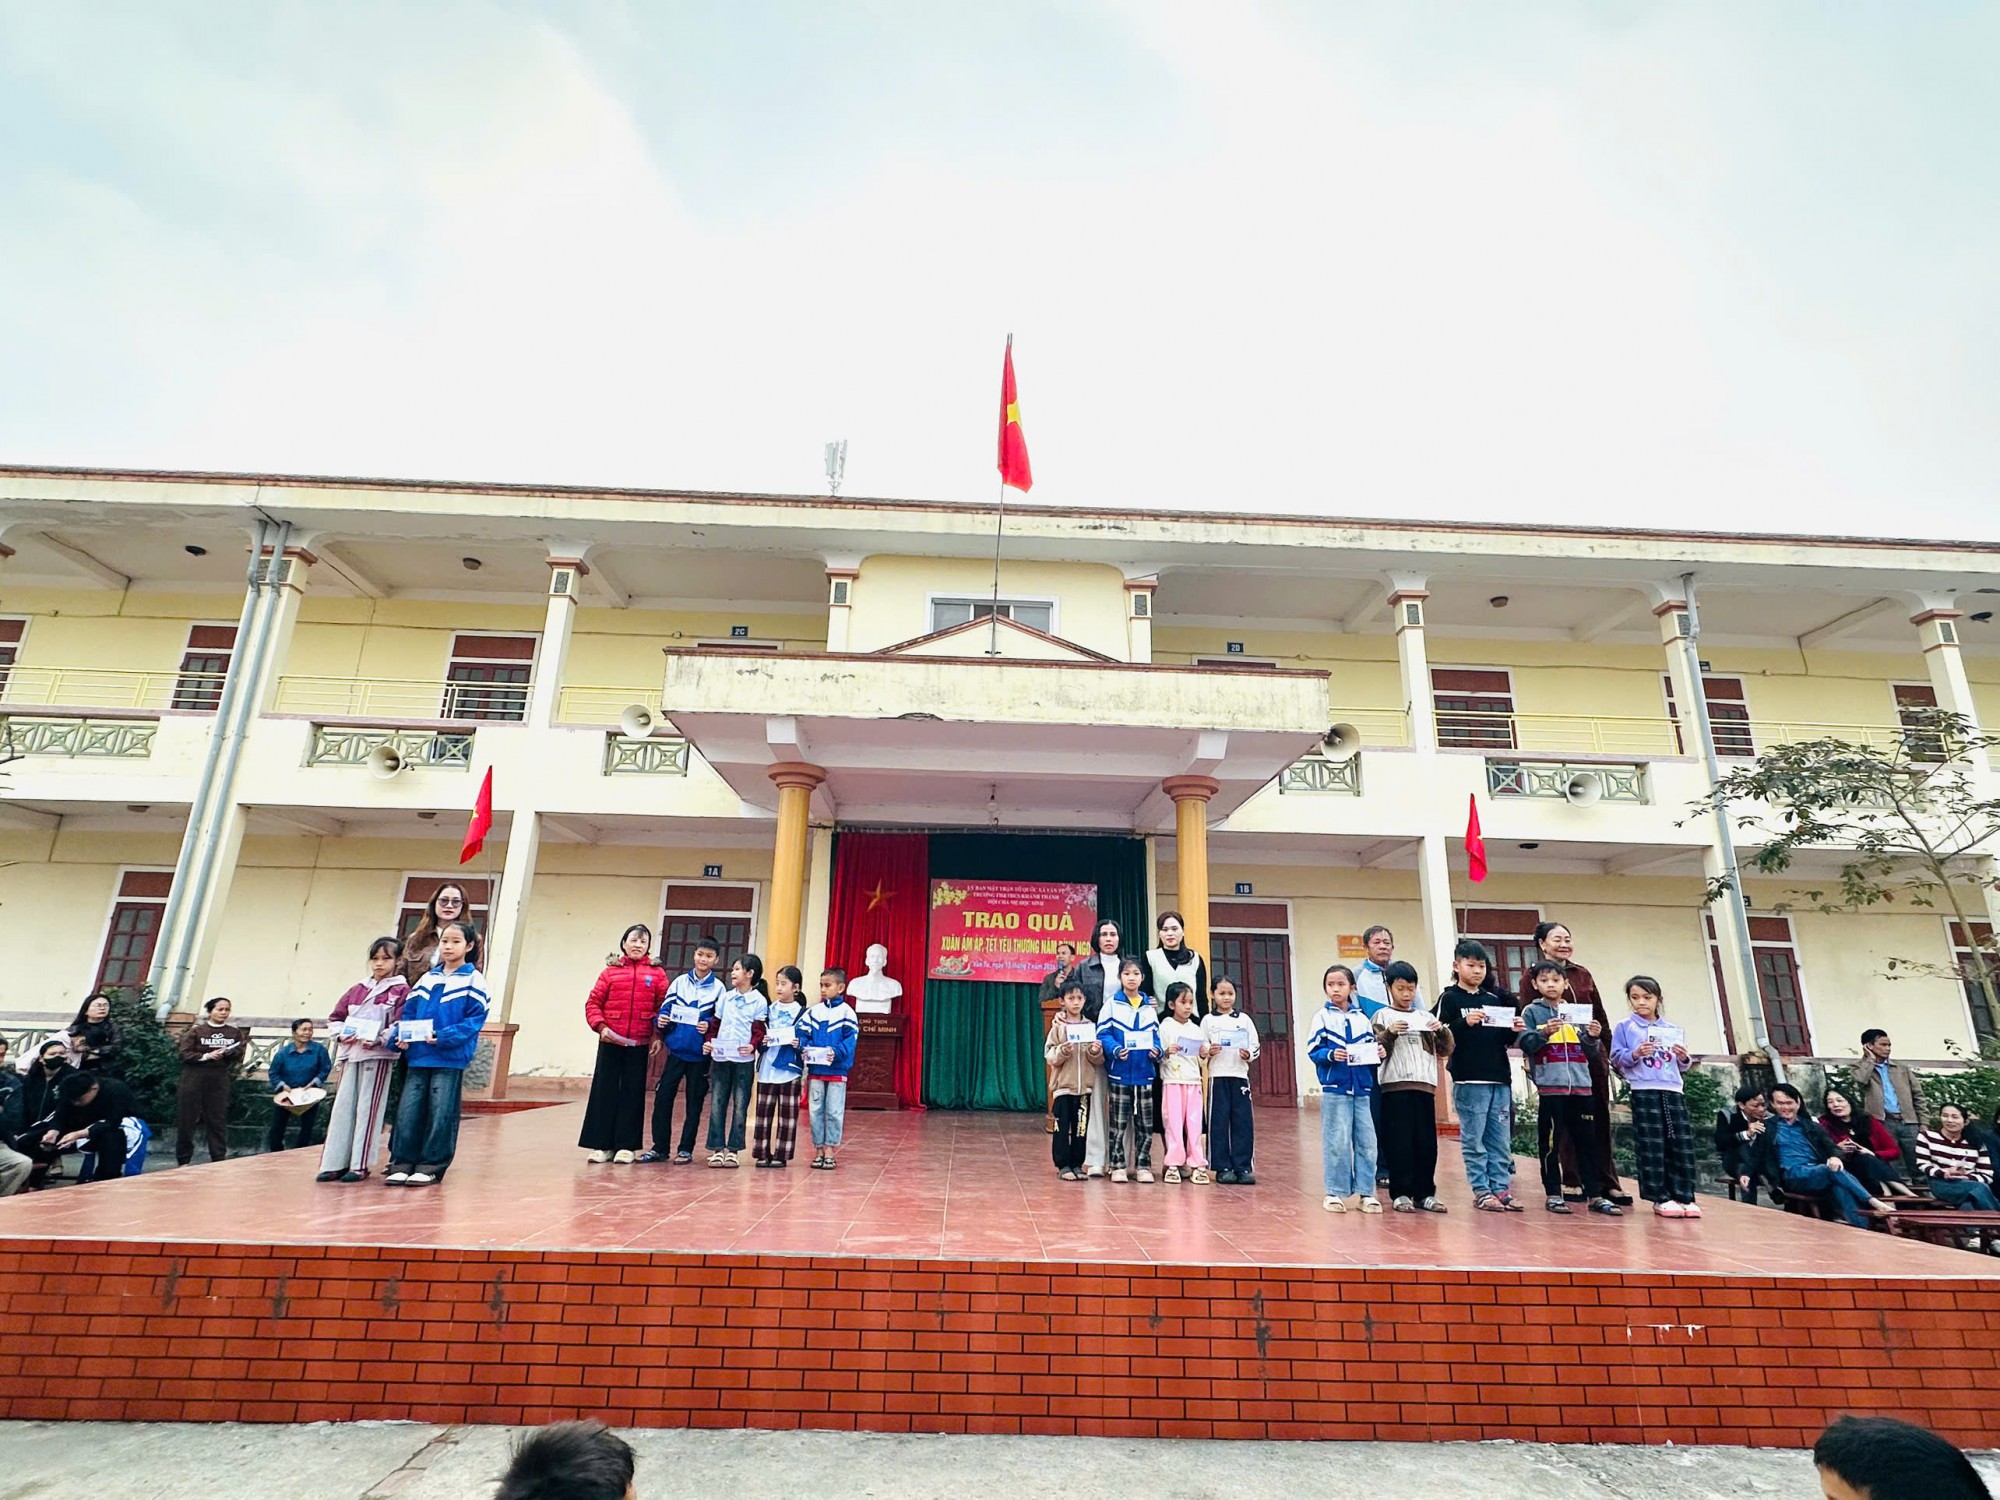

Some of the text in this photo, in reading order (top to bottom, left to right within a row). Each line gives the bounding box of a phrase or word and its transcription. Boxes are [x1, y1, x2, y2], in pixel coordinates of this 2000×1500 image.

[708, 867, 718, 876] 1A
[1240, 885, 1250, 893] 1B
[962, 911, 1074, 932] TRAO QUÀ
[941, 934, 960, 951] XUÂN
[961, 933, 973, 951] ẤM
[985, 933, 997, 953] TẾT
[999, 936, 1012, 953] YÊU
[1013, 938, 1040, 954] THƯƠNG
[1041, 937, 1057, 955] NĂM
